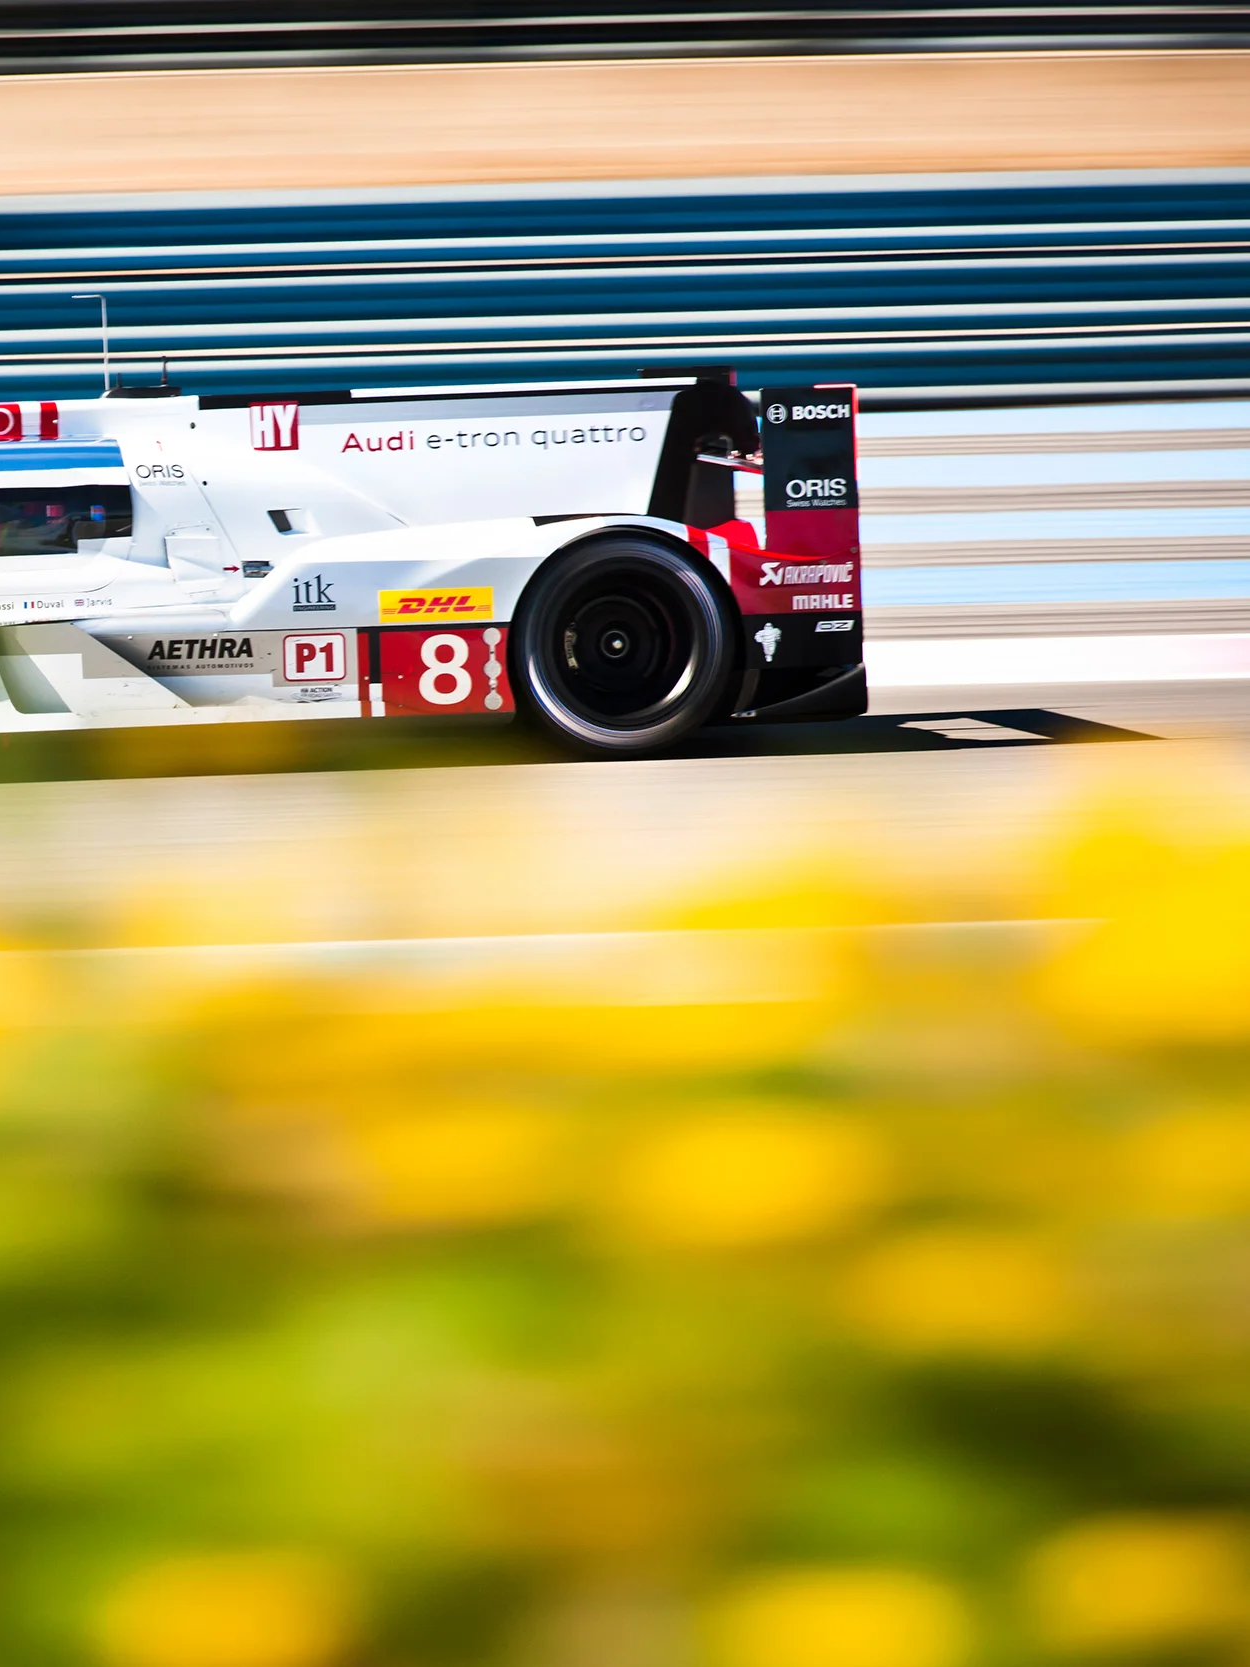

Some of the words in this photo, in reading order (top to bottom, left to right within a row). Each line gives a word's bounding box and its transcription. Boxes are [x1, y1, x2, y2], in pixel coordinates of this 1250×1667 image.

[792, 404, 851, 420] BOSCH
[251, 404, 298, 449] HY
[341, 430, 415, 453] Audi
[426, 430, 521, 449] e-tron
[531, 426, 647, 450] quattro
[136, 464, 185, 479] ORIS
[785, 478, 847, 498] ORIS
[292, 574, 337, 604] itk
[36, 600, 65, 609] Duval
[86, 598, 113, 608] Jarvis
[397, 595, 477, 614] DHL
[792, 593, 854, 610] MAHLE
[147, 637, 254, 660] AETHRA
[295, 642, 334, 674] P1
[418, 633, 472, 705] 8
